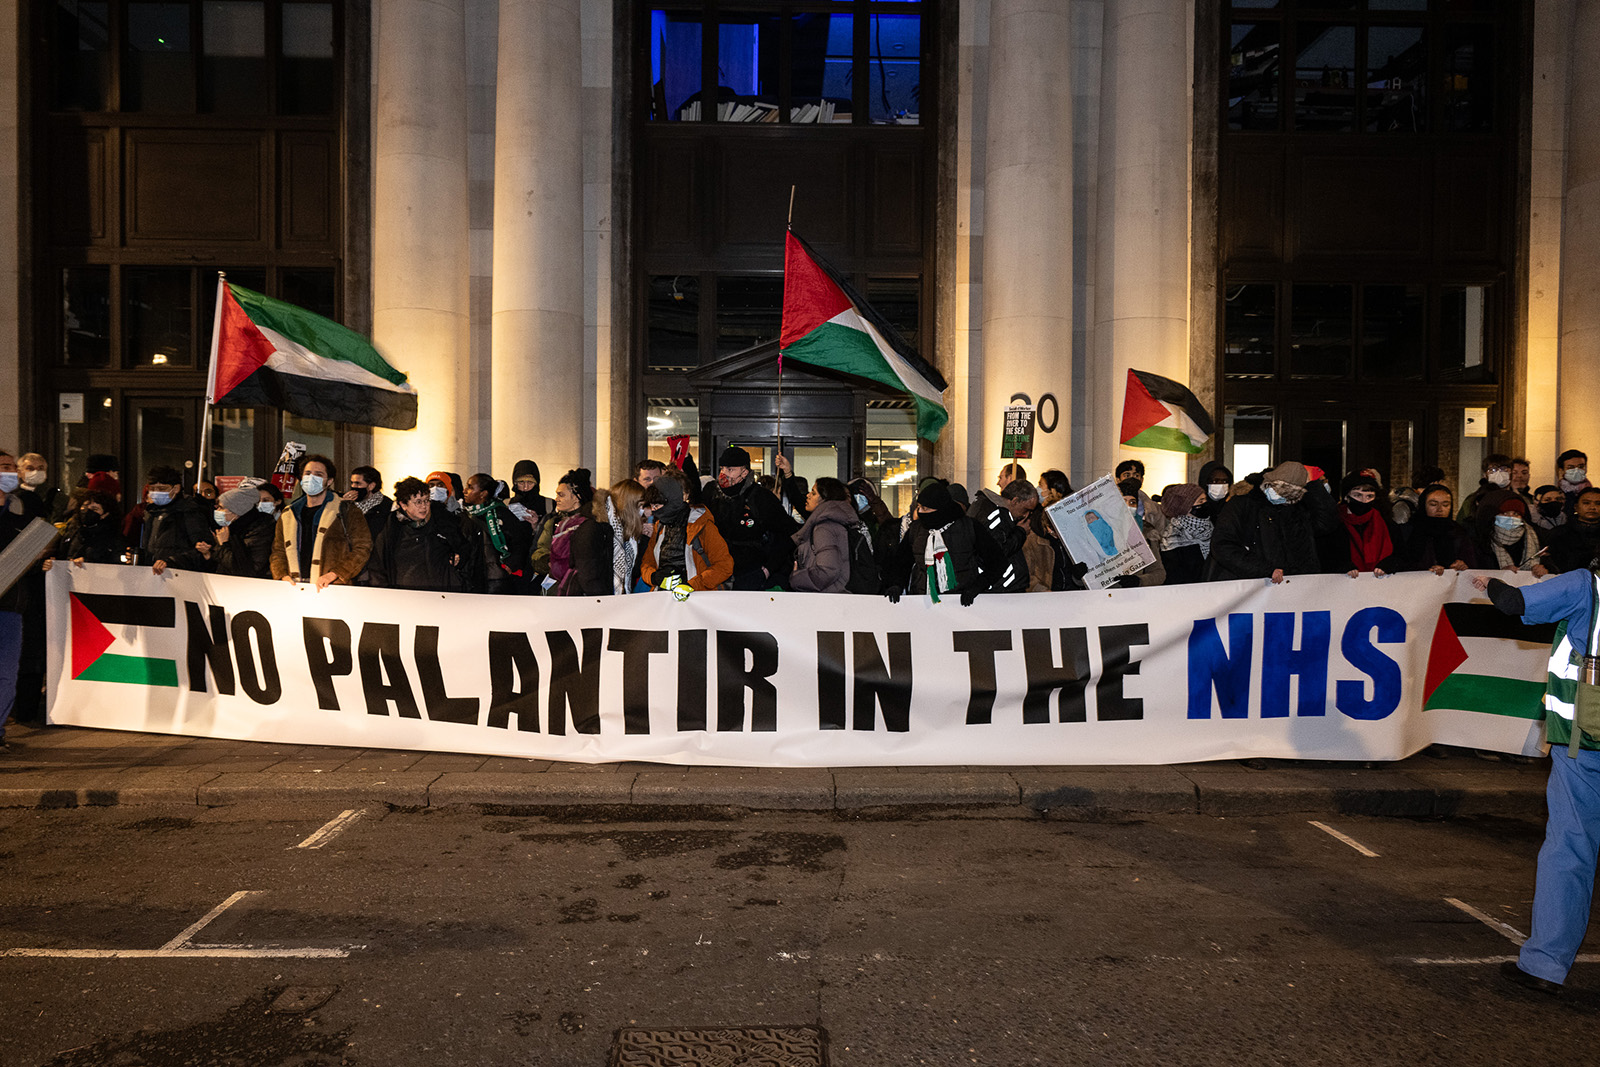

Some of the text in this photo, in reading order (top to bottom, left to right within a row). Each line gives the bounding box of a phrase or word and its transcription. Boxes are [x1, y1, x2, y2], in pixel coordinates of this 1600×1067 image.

[1007, 412, 1031, 420] FROM THE
[1020, 419, 1028, 427] TO
[1005, 427, 1025, 435] THE SEA
[1066, 507, 1077, 515] Too
[1075, 501, 1088, 511] soon
[1094, 561, 1106, 570] only
[1105, 552, 1123, 564] dreamt
[1129, 560, 1147, 572] Gaza
[1094, 570, 1105, 579] And
[1103, 565, 1117, 574] then
[1115, 560, 1125, 568] she
[184, 601, 1408, 736] NO PALANTIR IN THE NHS
